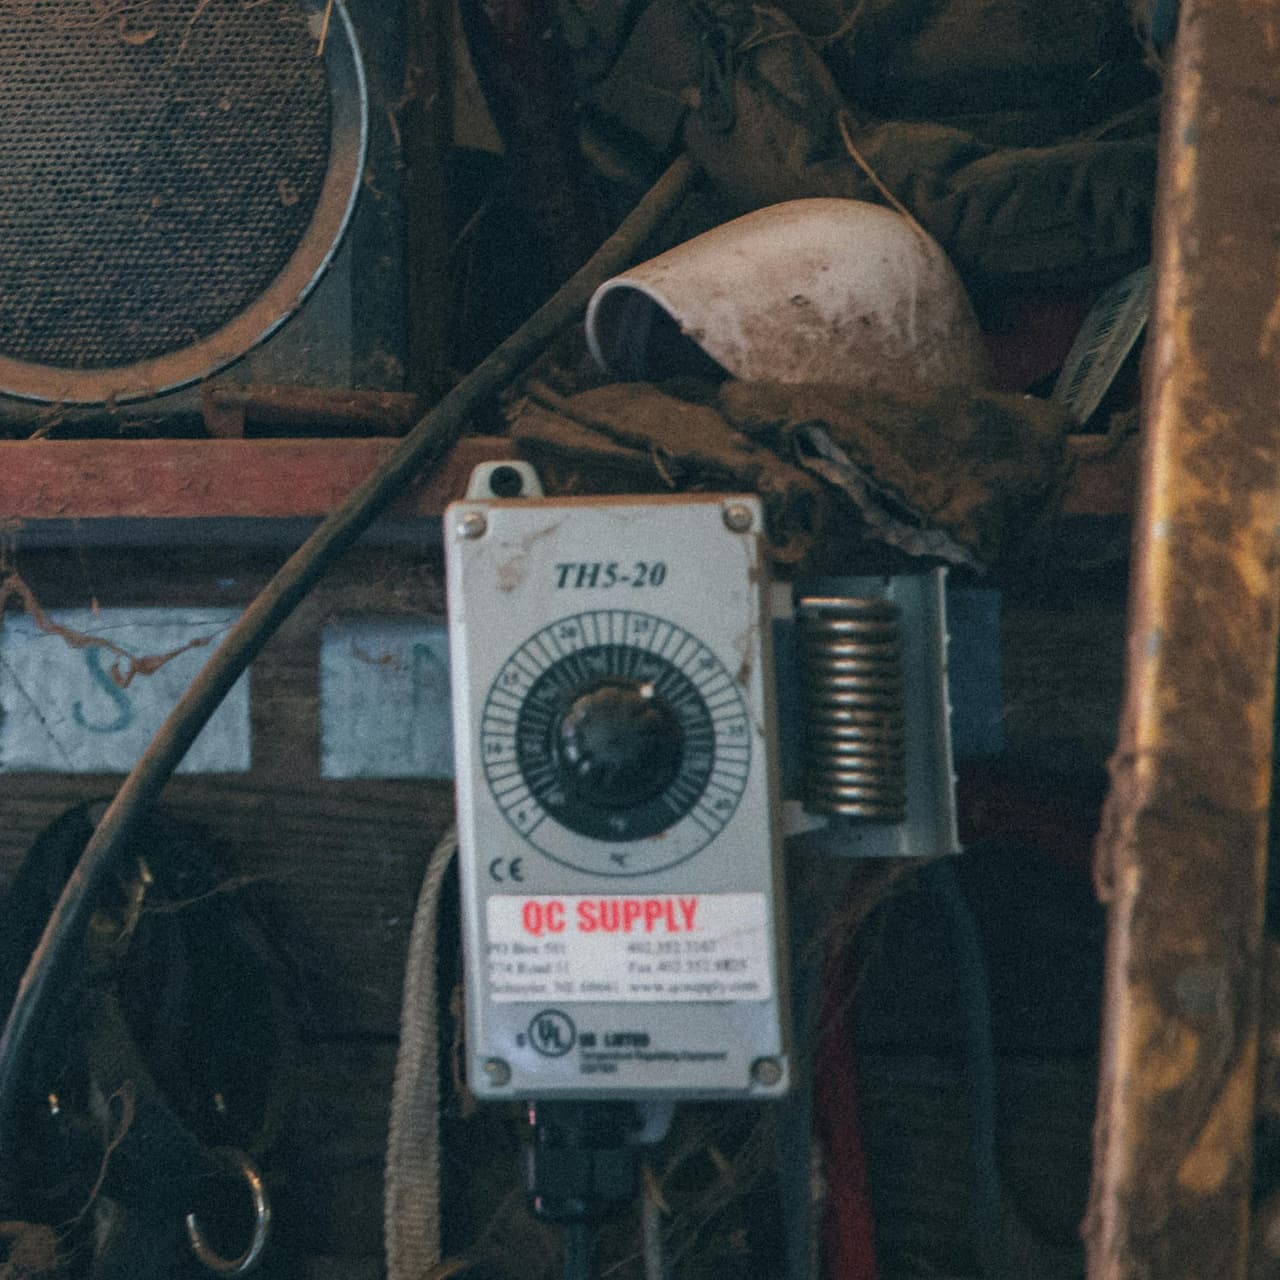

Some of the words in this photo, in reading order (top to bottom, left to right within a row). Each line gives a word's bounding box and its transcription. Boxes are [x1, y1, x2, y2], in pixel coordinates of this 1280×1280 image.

[554, 562, 667, 589] TH5-20
[521, 900, 566, 937] QC
[576, 897, 699, 934] SUPPLY
